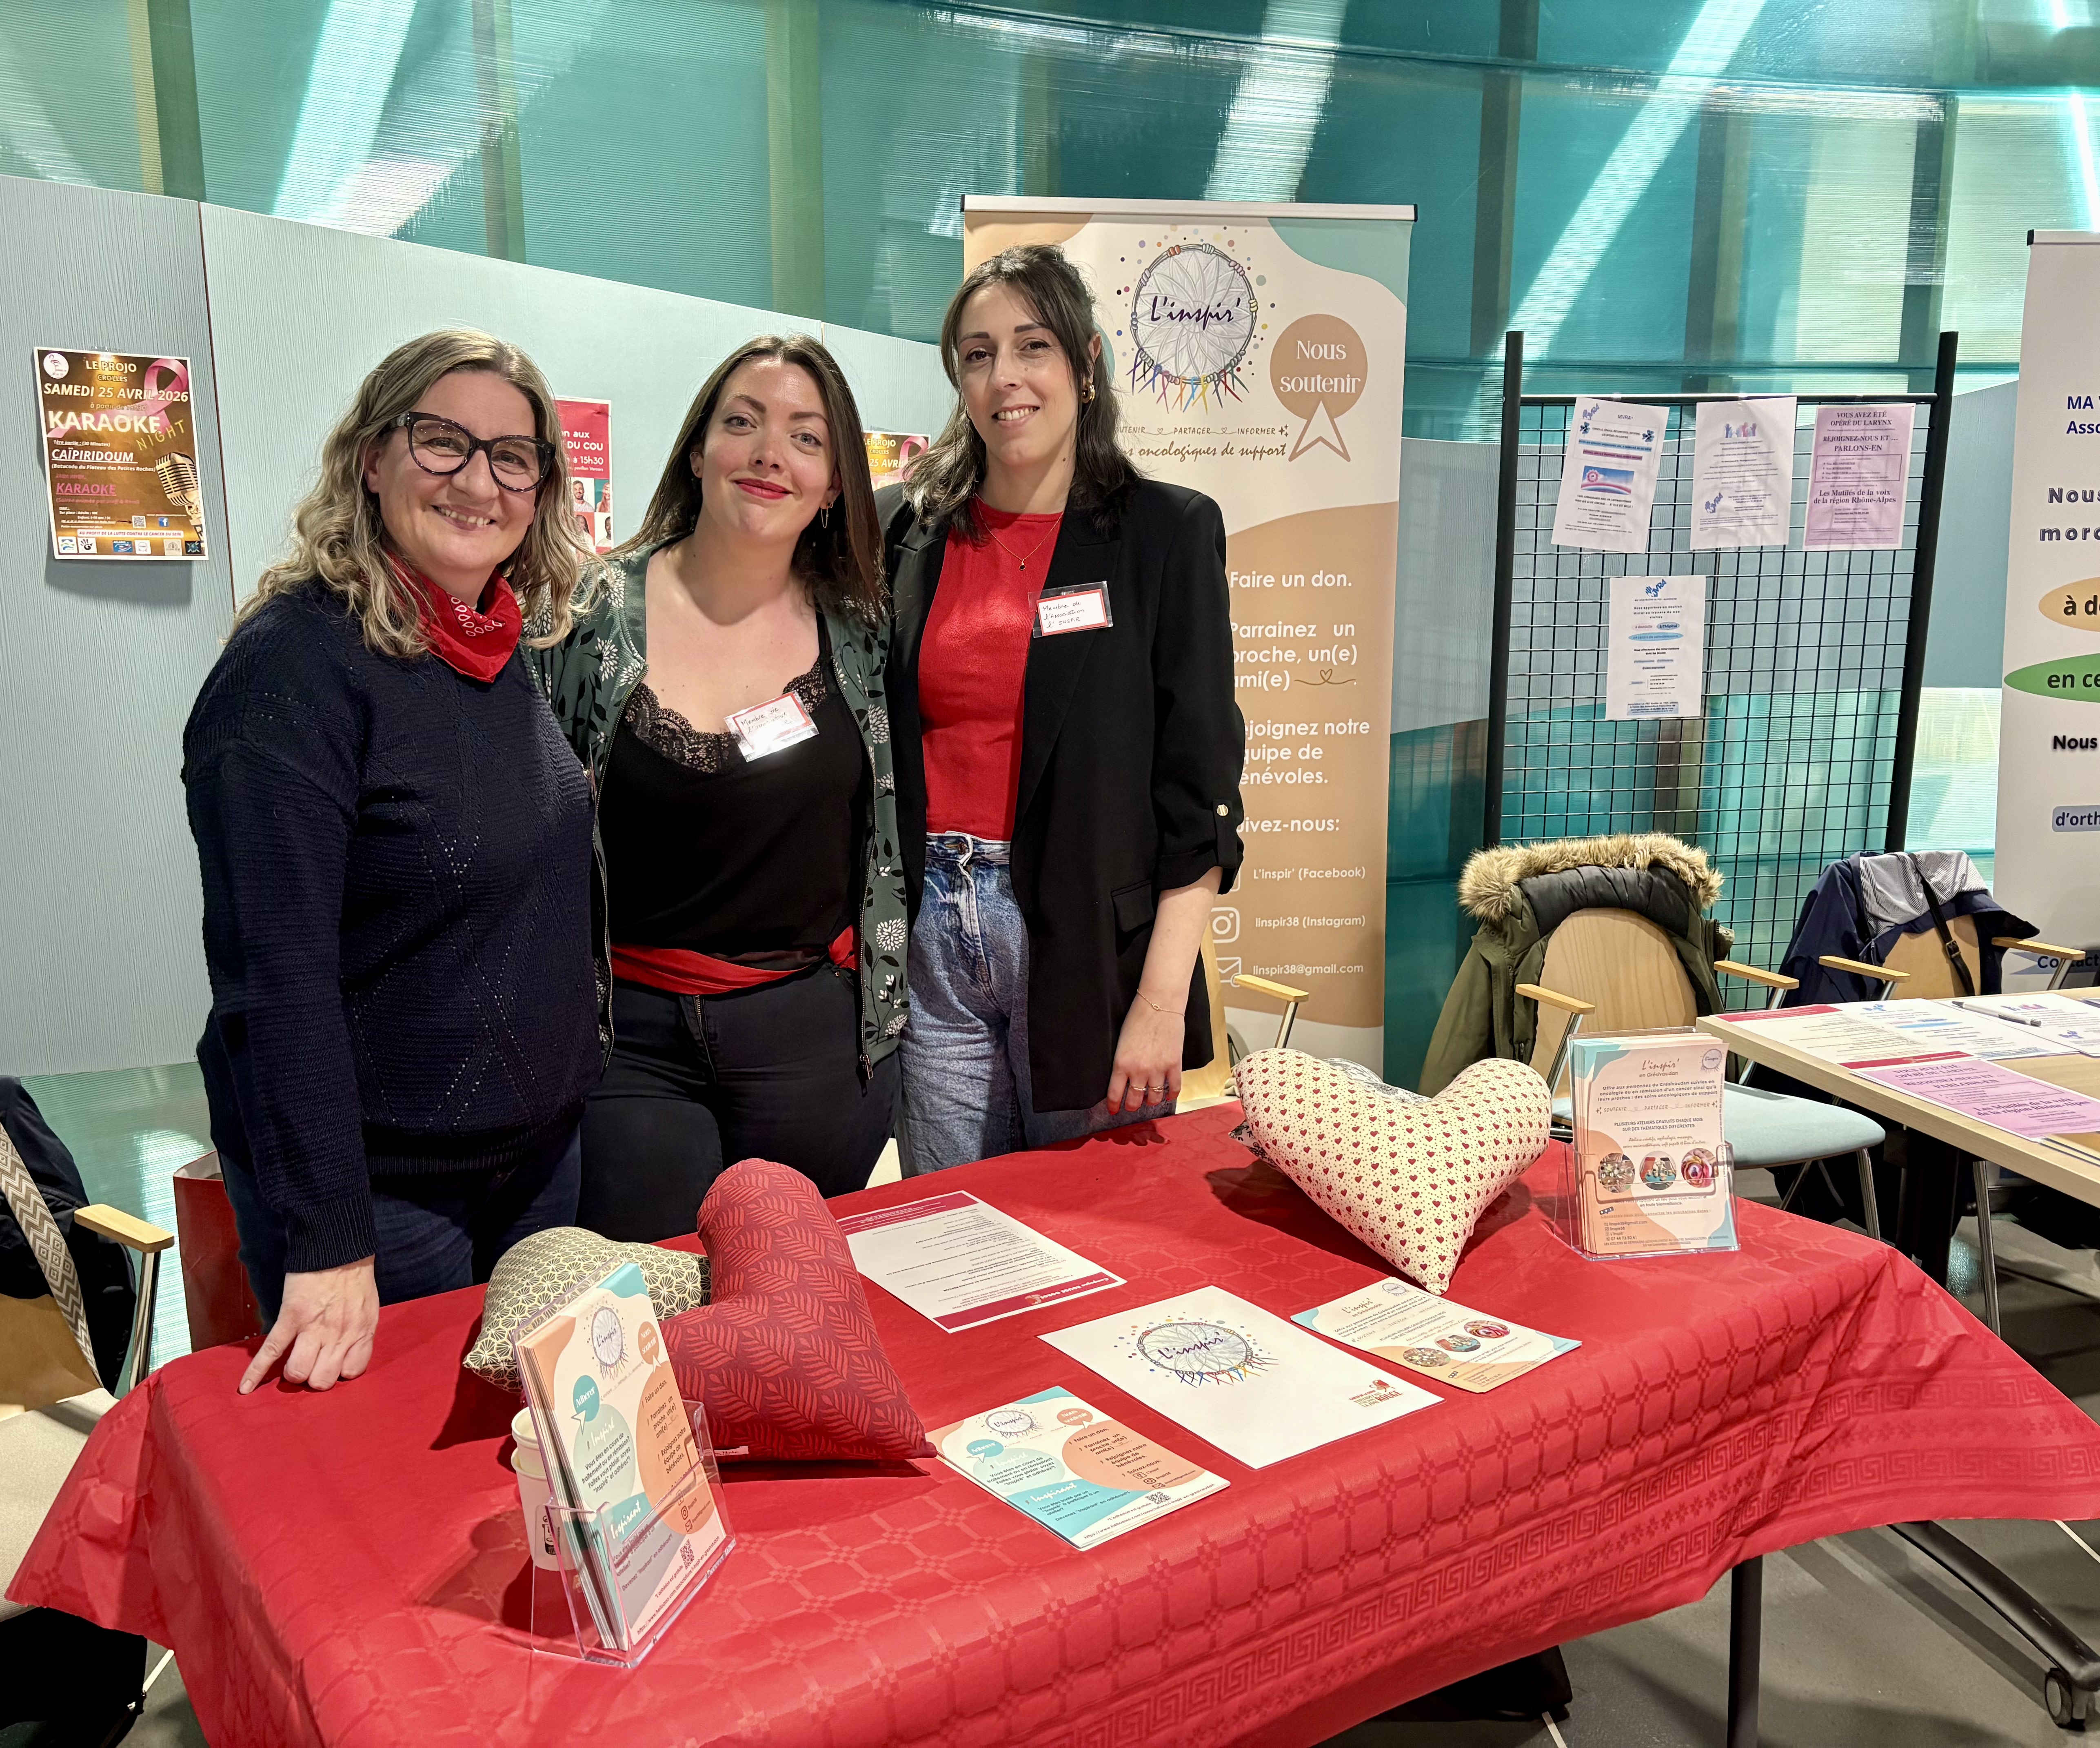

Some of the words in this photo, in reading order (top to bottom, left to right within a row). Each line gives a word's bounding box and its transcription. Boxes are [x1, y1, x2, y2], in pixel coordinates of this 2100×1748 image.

[1150, 295, 1241, 330] L'inspir'
[1296, 340, 1347, 360] Nous
[86, 360, 98, 369] LE
[101, 362, 137, 374] PROJO
[1280, 374, 1361, 393] soutenir
[44, 383, 94, 397] SAMEDI
[98, 387, 113, 397] 25
[117, 388, 154, 400] AVRIL
[158, 390, 189, 402] 2026
[2067, 396, 2094, 409] MA
[48, 410, 161, 434] KARAOKE
[135, 419, 185, 451] NIGHT
[1174, 427, 1211, 435] PARTAGER
[567, 441, 580, 449] DU
[583, 442, 603, 451] COU
[872, 439, 896, 448] PROJO
[52, 447, 134, 461] CAÏPIRIDOUM
[1138, 441, 1216, 462] oncologiques
[1221, 441, 1234, 455] de
[1238, 443, 1287, 461] support
[580, 456, 604, 465] 15h30
[870, 459, 879, 467] 25
[56, 483, 116, 494] KARAOKE
[2048, 488, 2100, 503] Nou
[1230, 571, 1275, 588] Faire
[1281, 573, 1305, 588] un
[1311, 570, 1352, 588] don.
[2063, 594, 2077, 616] à
[1230, 621, 1316, 638] Parrainez
[1333, 623, 1355, 637] un
[1308, 644, 1357, 665] un(e)
[2047, 673, 2075, 688] en
[741, 714, 765, 726] Membre
[1245, 719, 1319, 740] joignez
[1324, 718, 1370, 735] notre
[2053, 735, 2098, 750] Nous
[1245, 744, 1292, 764] uipe
[1298, 743, 1323, 760] de
[1239, 766, 1328, 785] énévoles.
[1236, 816, 1340, 833] uivez-nous:
[1253, 868, 1295, 881] L'inspir'
[1298, 867, 1365, 881] (Facebook)
[1255, 917, 1299, 929] linspir38
[1303, 916, 1365, 928] (Instagram)
[1253, 964, 1364, 976] linspir38@gmail.com
[1642, 1058, 1679, 1072] L'inspir'
[1156, 1331, 1225, 1360] L'inspir'
[1374, 1391, 1403, 1402] ROUGE
[585, 1459, 595, 1470] Vous
